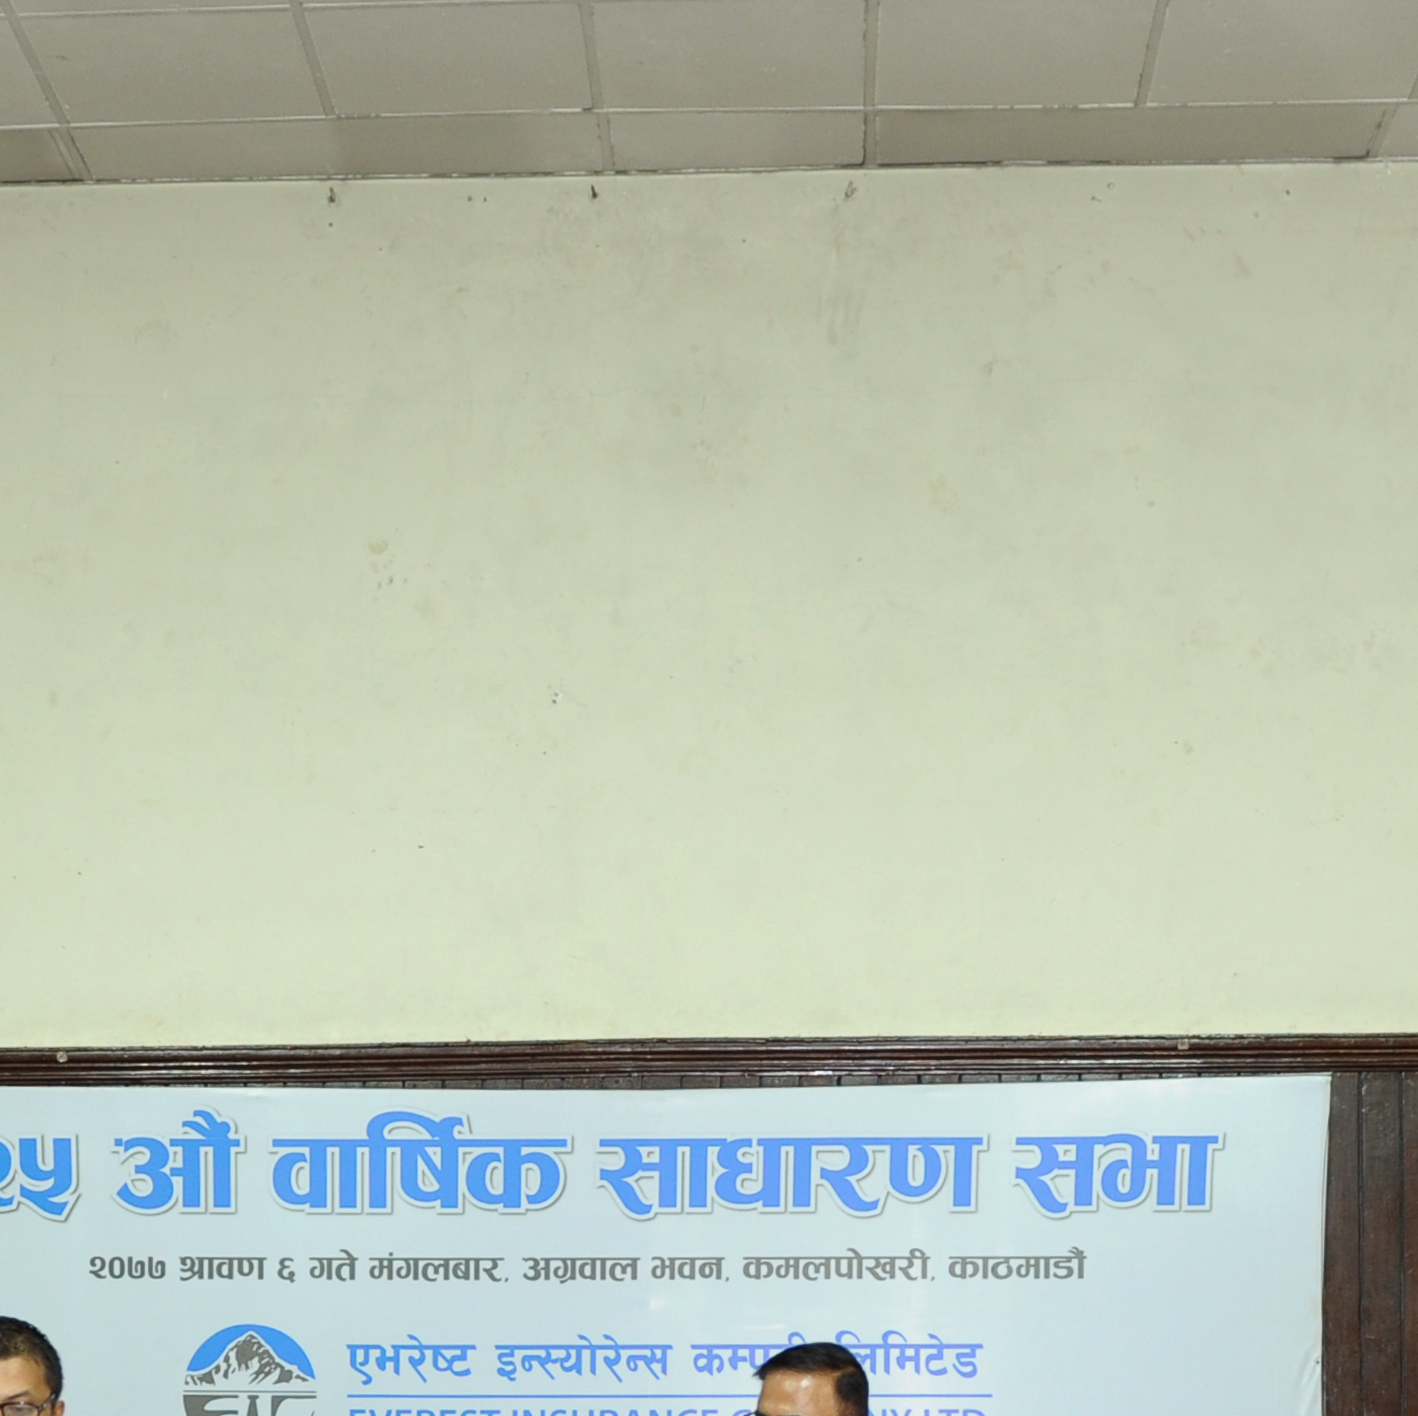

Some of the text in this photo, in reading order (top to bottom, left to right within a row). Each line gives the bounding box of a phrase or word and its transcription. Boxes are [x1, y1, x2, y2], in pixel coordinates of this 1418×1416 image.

[272, 1110, 571, 1213] वार्षिक
[598, 1135, 987, 1218] साधारण
[1015, 1132, 1222, 1217] सभा
[88, 1256, 167, 1282] २०७७
[179, 1255, 268, 1283] श्रावण
[277, 1257, 297, 1284] ६
[309, 1249, 360, 1284] गते
[522, 1257, 642, 1285] अग्रवाल
[345, 1333, 479, 1386] एभरेष्ट
[494, 1333, 675, 1383] इन्स्योरेन्स
